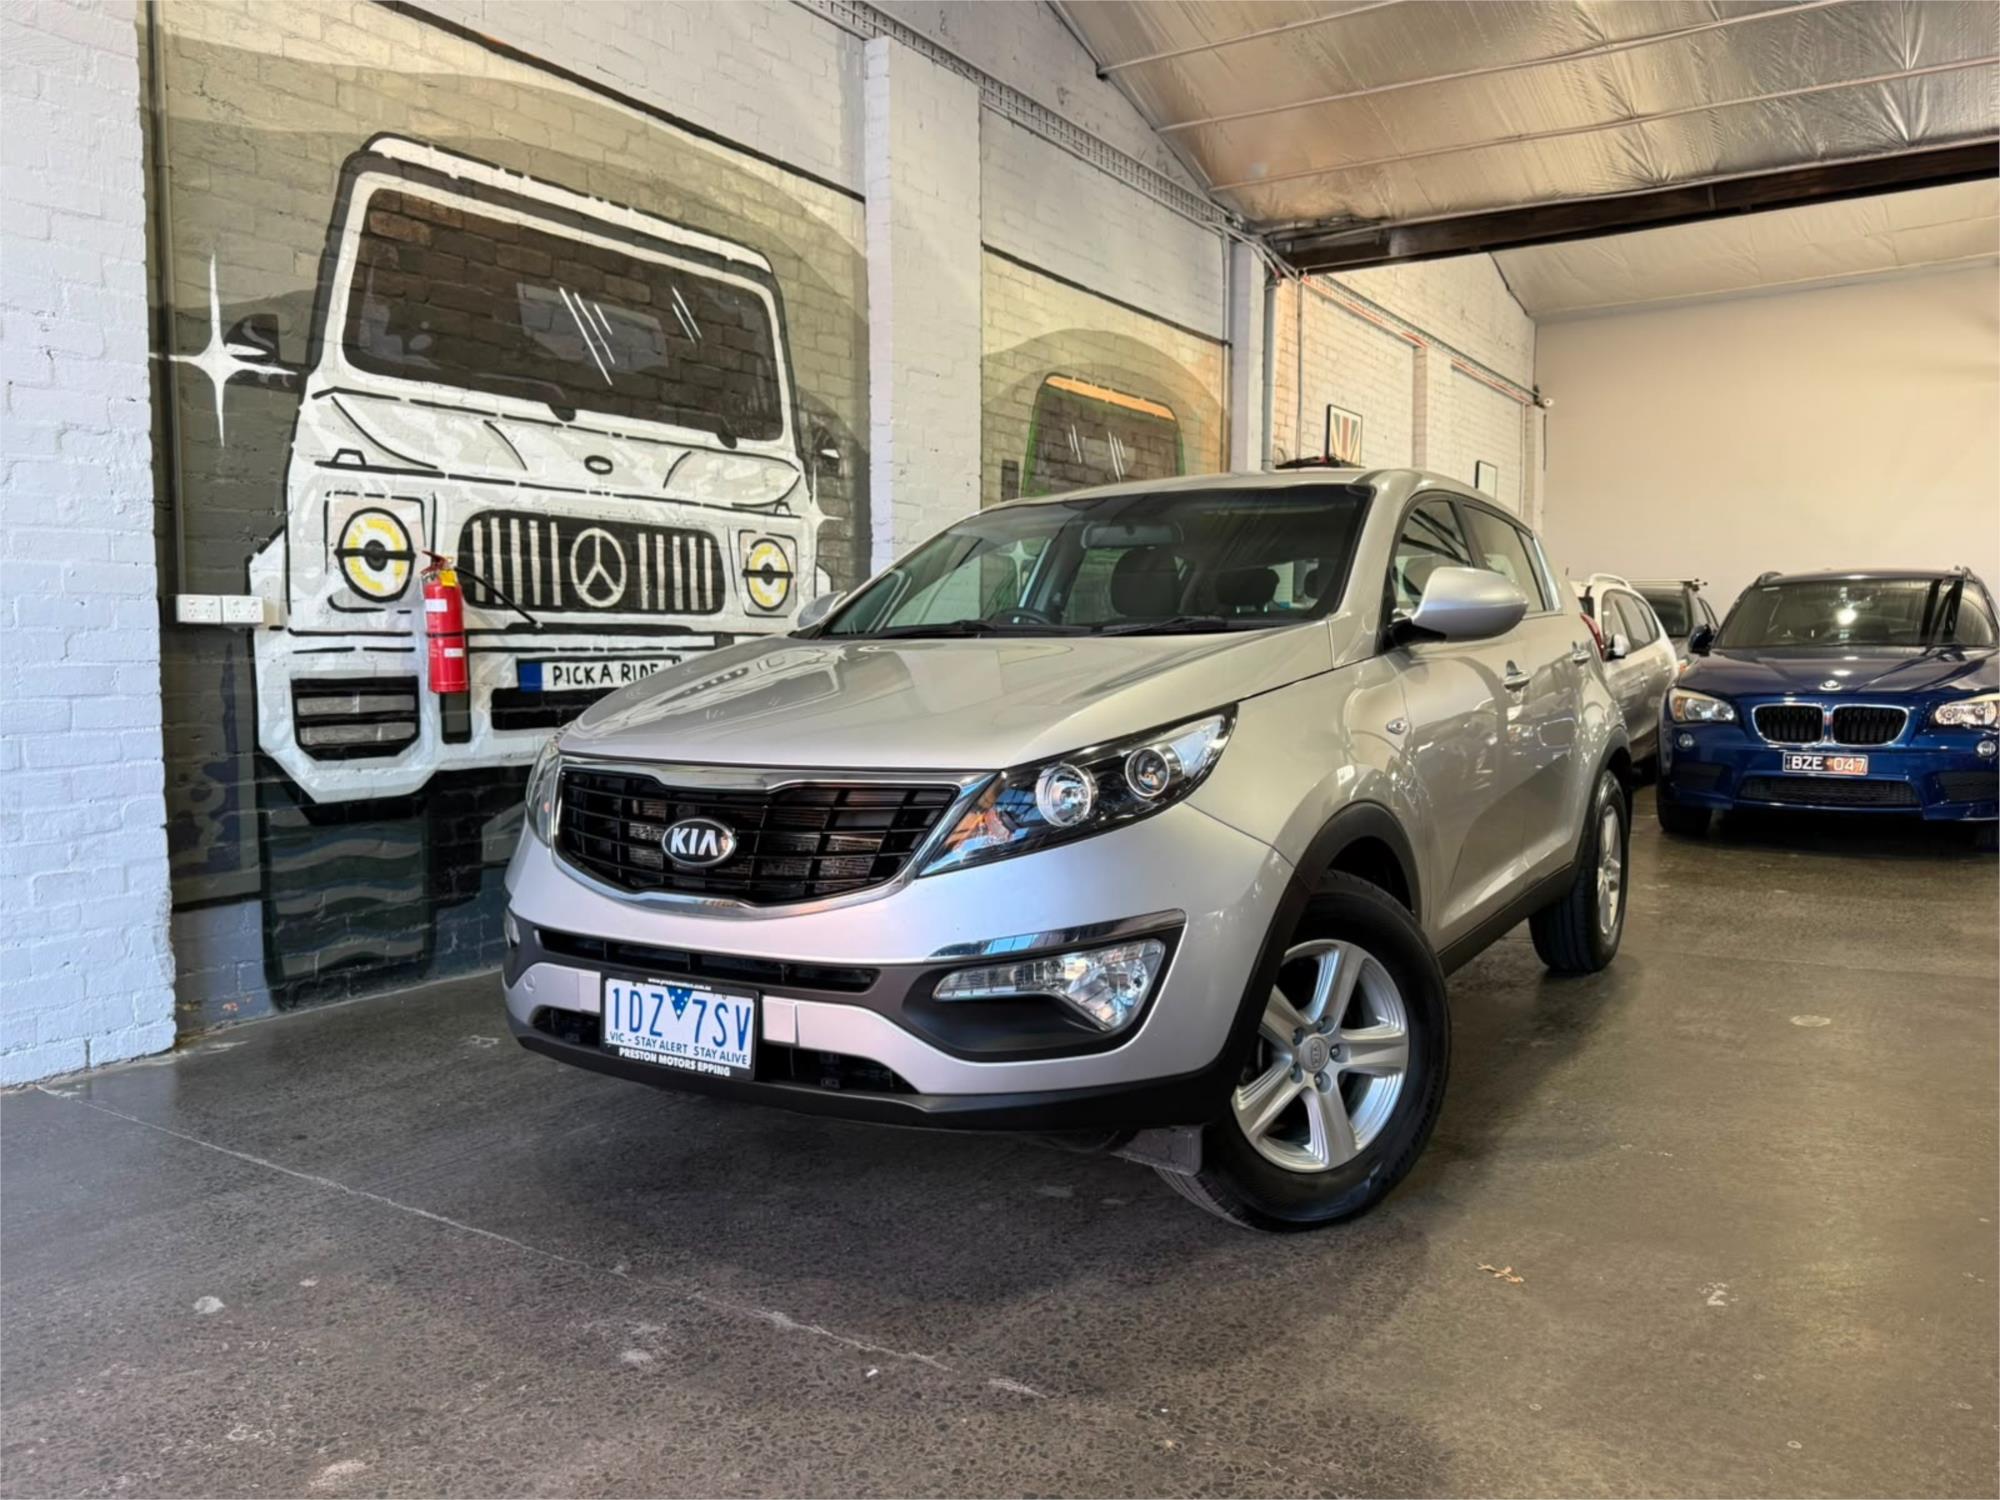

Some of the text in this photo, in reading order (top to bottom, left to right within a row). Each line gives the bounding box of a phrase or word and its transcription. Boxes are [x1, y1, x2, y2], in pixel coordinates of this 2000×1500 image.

[552, 665, 597, 686] PICK
[600, 664, 614, 684] A
[1791, 755, 1824, 771] BZE
[1833, 757, 1865, 772] 047
[670, 827, 719, 856] KIA
[613, 988, 751, 1051] 1DZ 7SV
[609, 1031, 625, 1044] VIC
[634, 1036, 658, 1051] STAY
[659, 1040, 689, 1056] ALERT
[692, 1045, 718, 1060] STAY
[718, 1051, 748, 1066] ALIVE
[618, 1047, 731, 1078] PRESTON MOTORS EPPING
